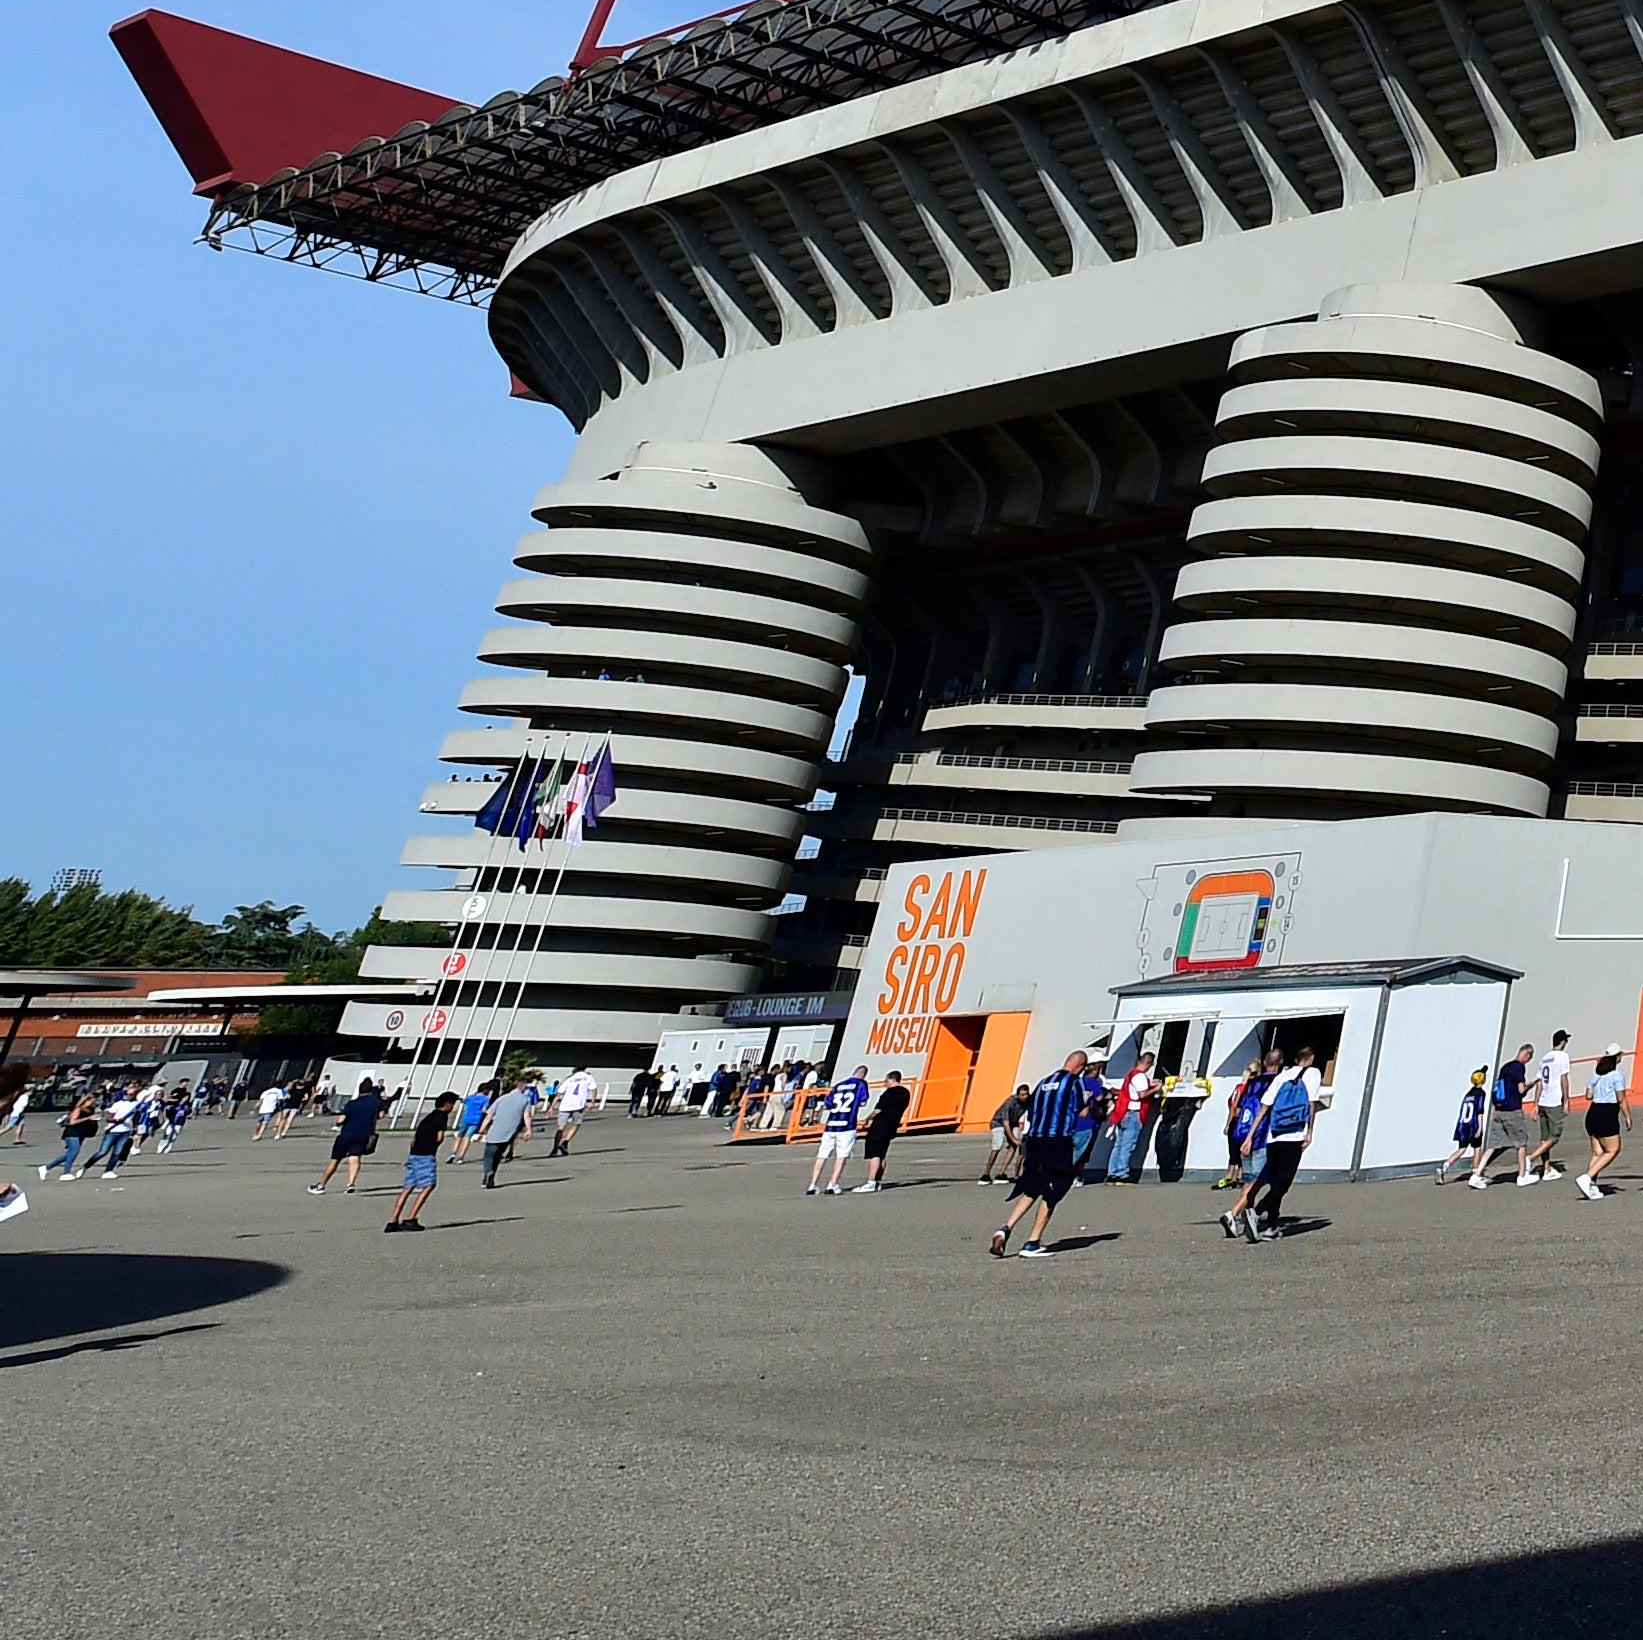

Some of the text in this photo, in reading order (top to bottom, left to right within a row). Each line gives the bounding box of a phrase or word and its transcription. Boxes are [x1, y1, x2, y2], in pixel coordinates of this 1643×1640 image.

[897, 868, 987, 943] SAN
[878, 942, 965, 1015] SIRO
[866, 1016, 935, 1055] MUSEU
[1542, 1065, 1550, 1084] 9
[830, 1092, 855, 1113] 32
